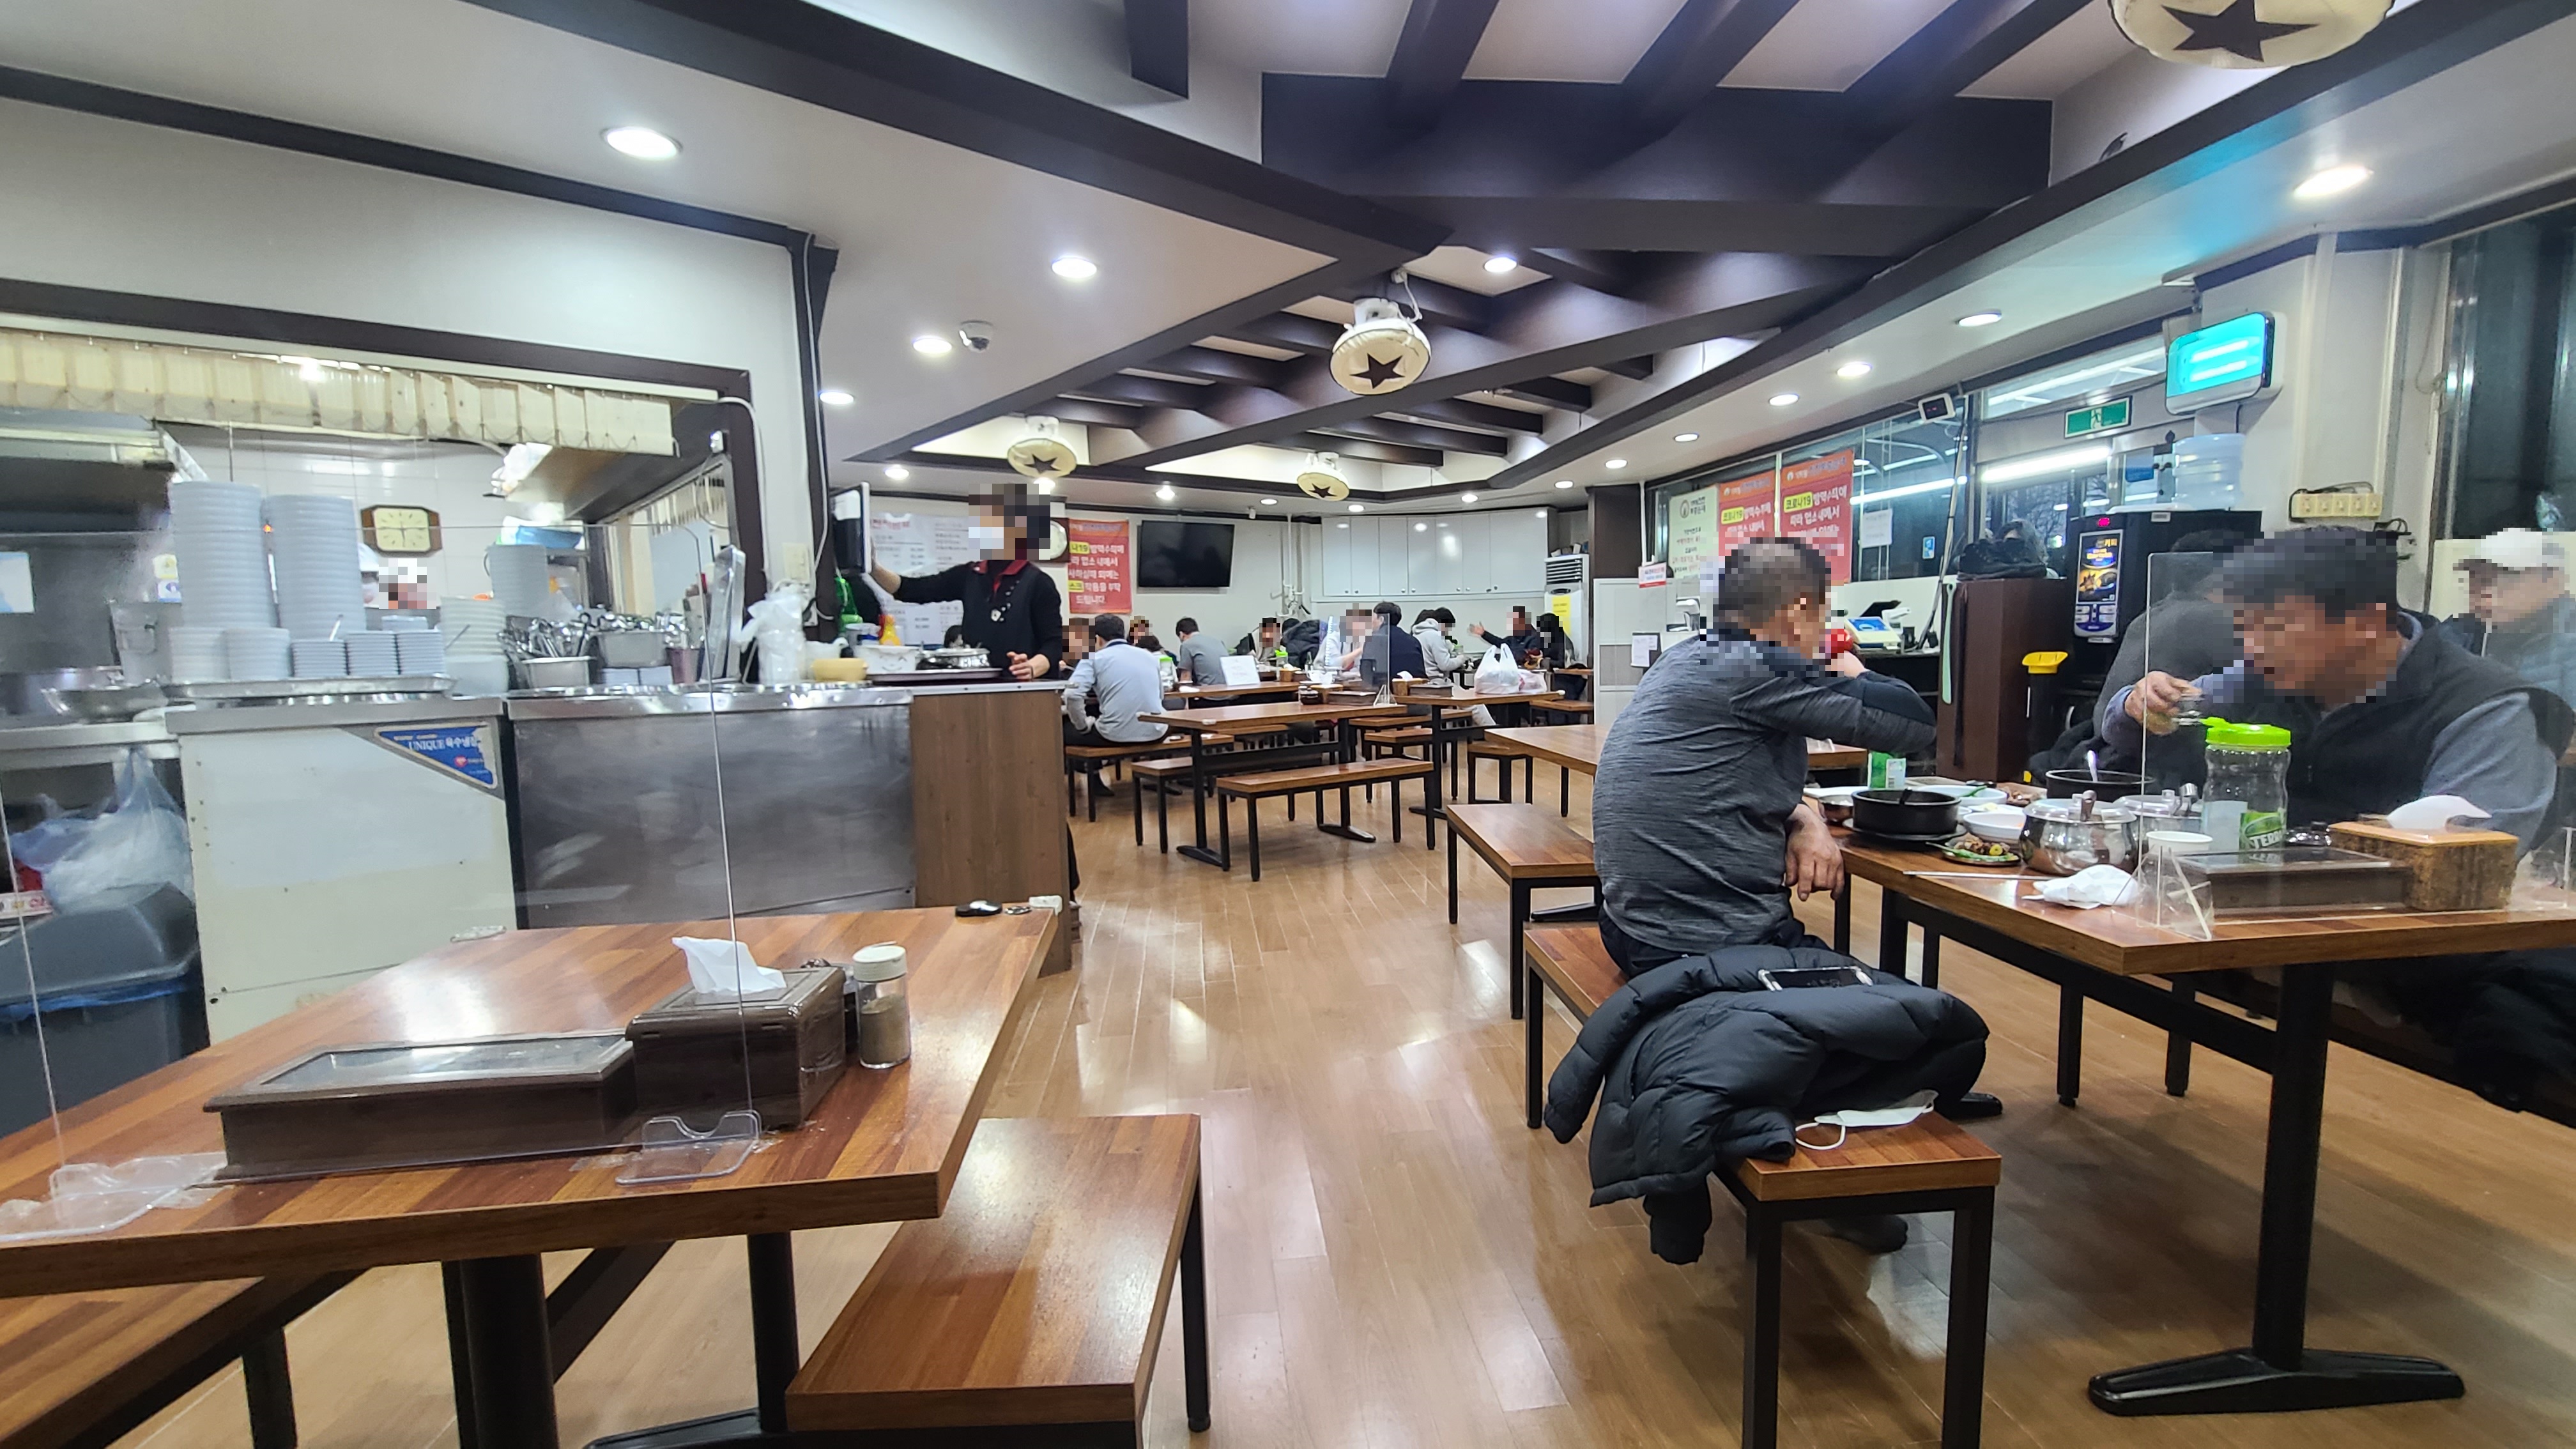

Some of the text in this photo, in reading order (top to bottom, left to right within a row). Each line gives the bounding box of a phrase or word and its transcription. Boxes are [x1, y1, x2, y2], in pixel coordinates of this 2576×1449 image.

[1786, 494, 1811, 510] 코로나19
[1804, 511, 1817, 525] 업소
[408, 739, 445, 751] UNIQUE
